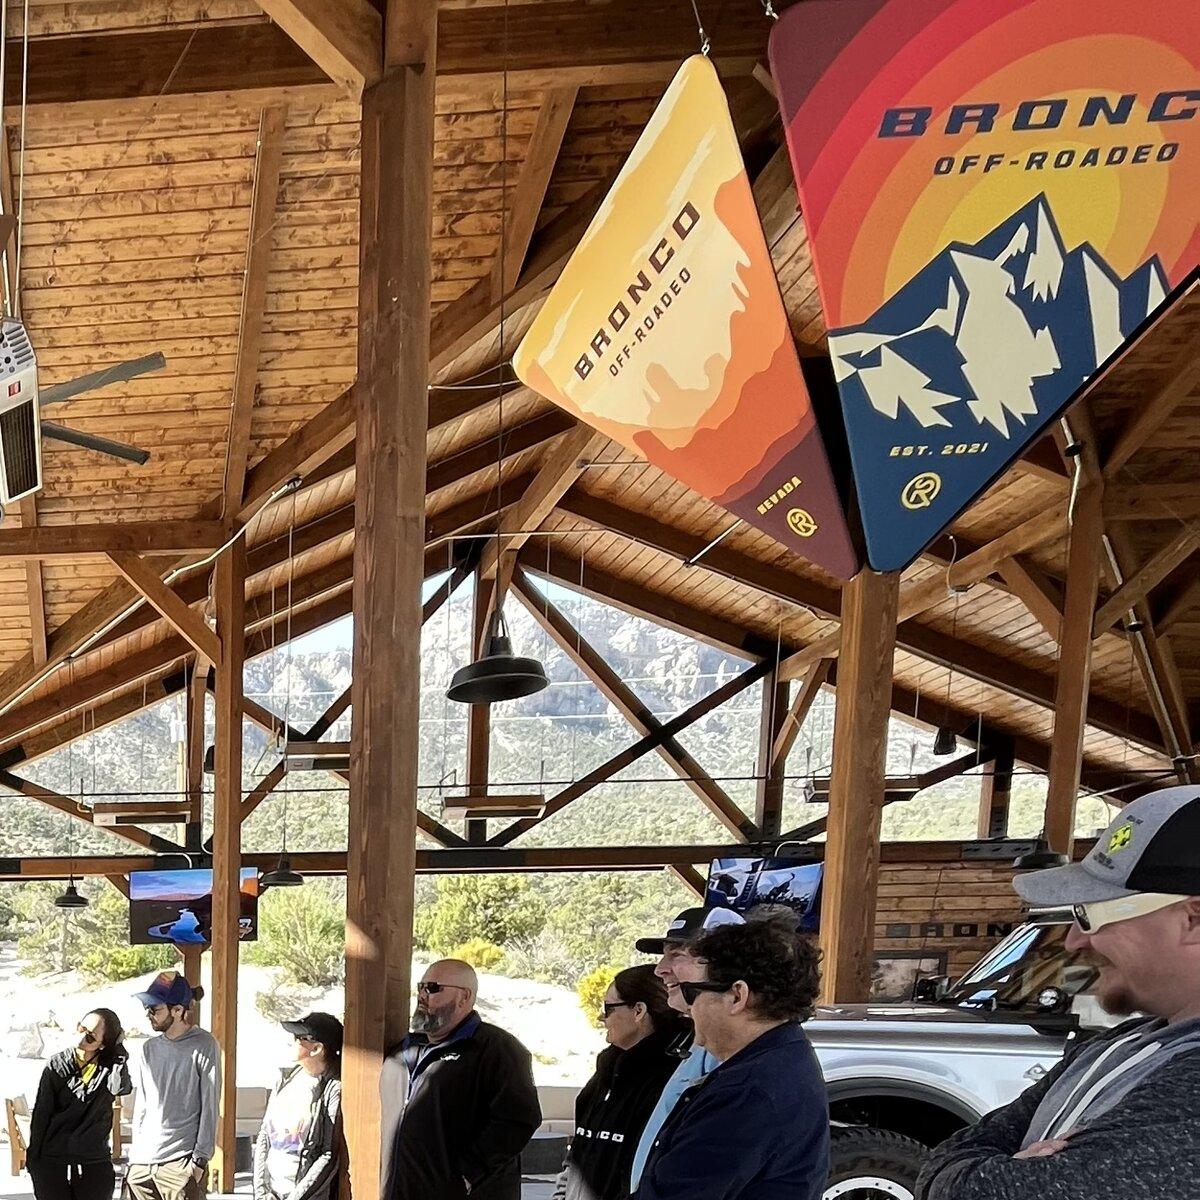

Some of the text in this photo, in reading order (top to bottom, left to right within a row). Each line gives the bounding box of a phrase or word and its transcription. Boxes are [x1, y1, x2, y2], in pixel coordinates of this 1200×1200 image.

[933, 142, 1179, 176] OFF-ROADEO
[574, 201, 701, 381] BRONCO
[608, 267, 691, 377] OFF-ROADEO
[889, 442, 989, 457] EST. 2021
[756, 475, 802, 515] NEVADA
